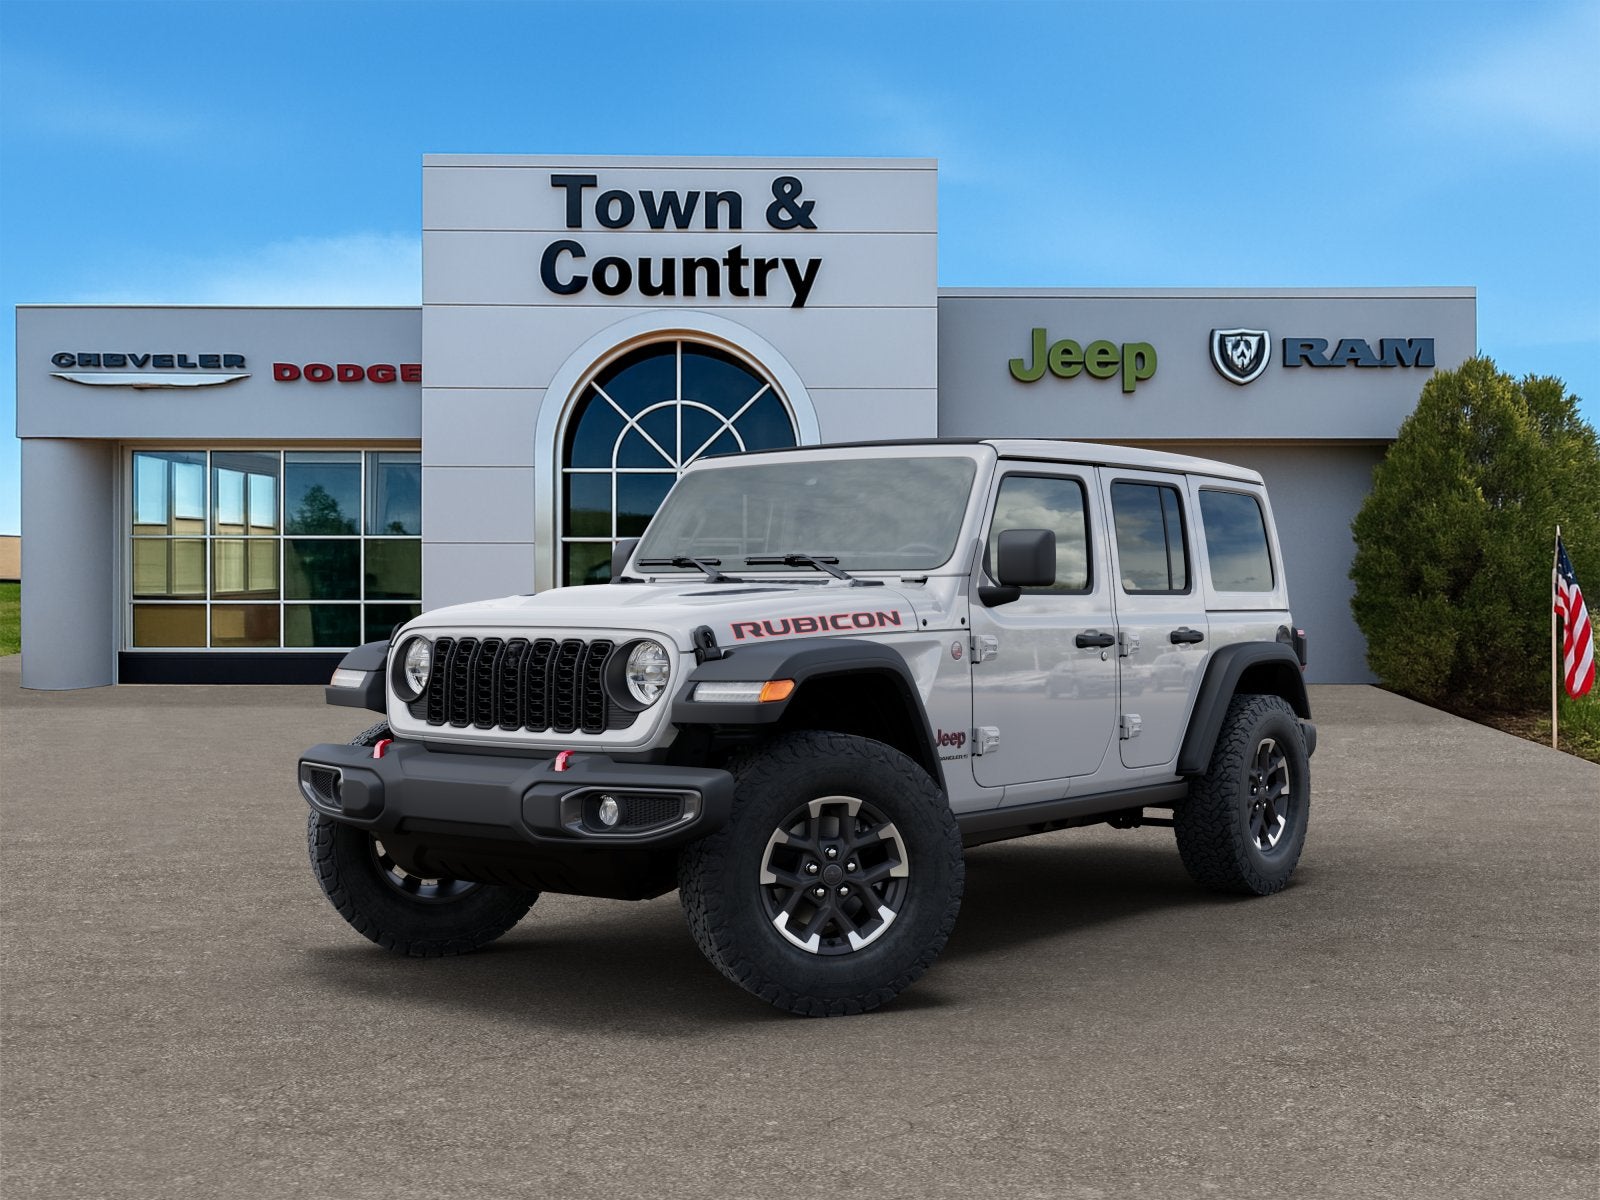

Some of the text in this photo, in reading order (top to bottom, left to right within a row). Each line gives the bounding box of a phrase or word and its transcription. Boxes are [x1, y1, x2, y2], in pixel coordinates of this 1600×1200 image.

[551, 174, 818, 229] Town &
[540, 239, 822, 308] Country
[1009, 328, 1158, 393] Jeep
[1282, 337, 1436, 368] RAM
[273, 363, 422, 383] DODGE
[730, 610, 902, 640] RUBICON
[936, 728, 966, 749] Jeep
